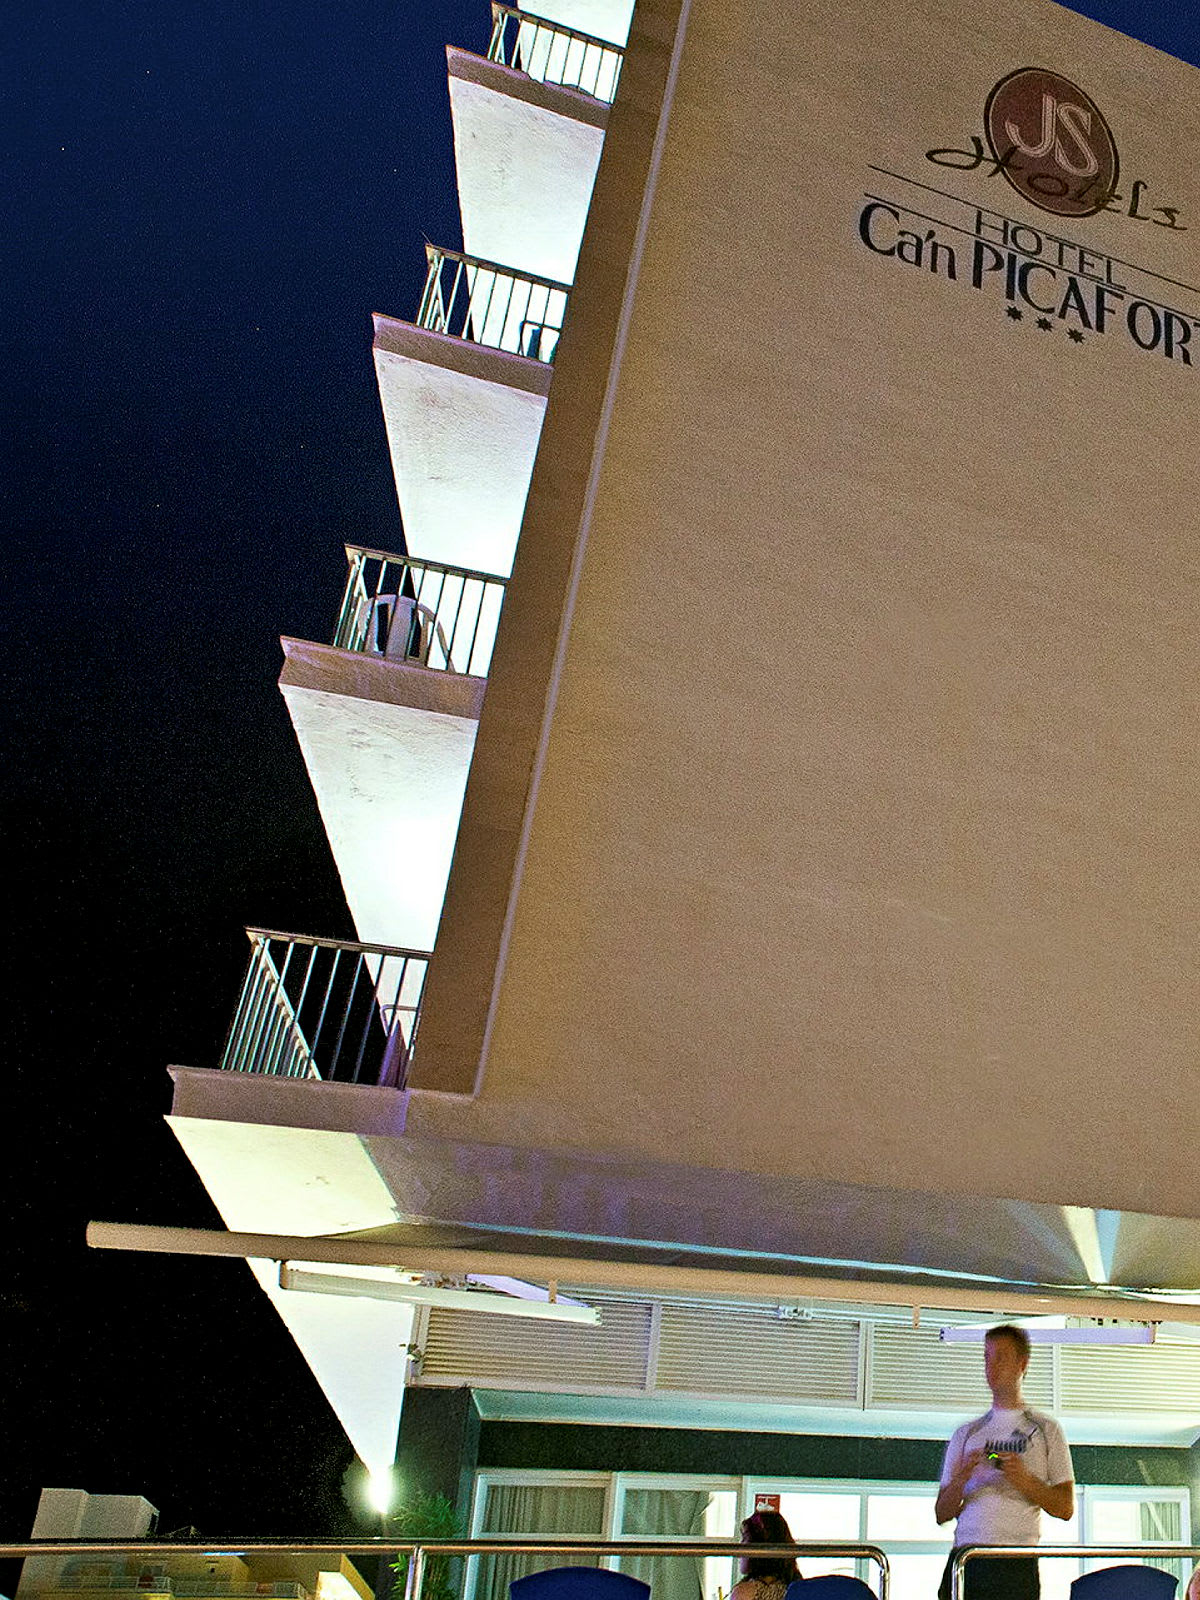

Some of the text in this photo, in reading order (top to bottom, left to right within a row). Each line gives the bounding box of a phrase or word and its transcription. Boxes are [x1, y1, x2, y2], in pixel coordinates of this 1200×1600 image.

[1004, 93, 1099, 177] JS
[924, 135, 1188, 231] Hotels
[858, 202, 957, 281] Ca'n
[975, 209, 1127, 290] HOTEL
